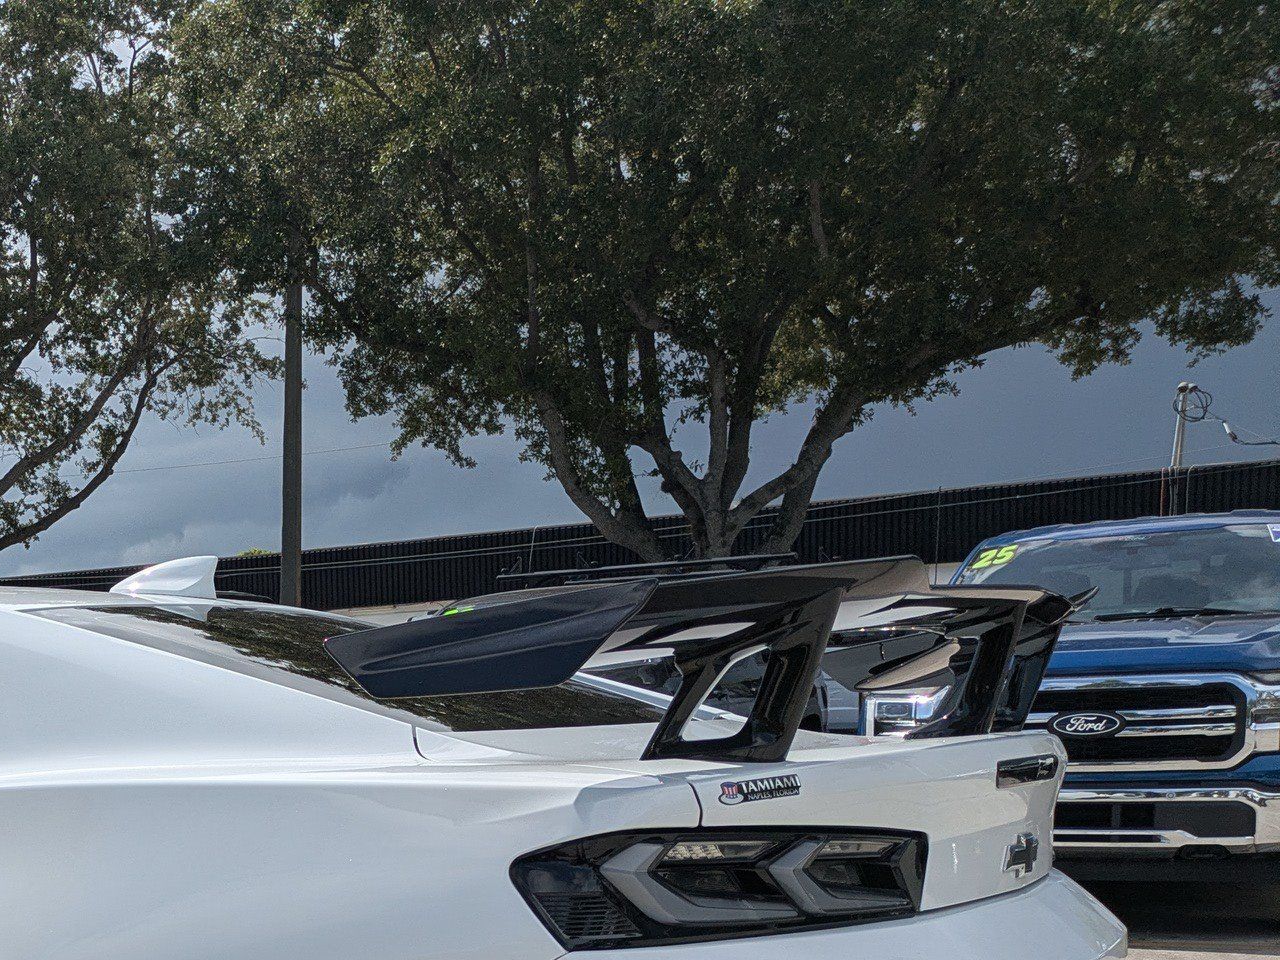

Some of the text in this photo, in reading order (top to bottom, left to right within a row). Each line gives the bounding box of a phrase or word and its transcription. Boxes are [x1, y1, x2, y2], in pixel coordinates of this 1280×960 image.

[971, 544, 1018, 569] 25
[1065, 716, 1108, 732] Ford
[740, 776, 800, 793] TAMIAMI
[747, 788, 799, 801] NAPLES, FLORIDA
